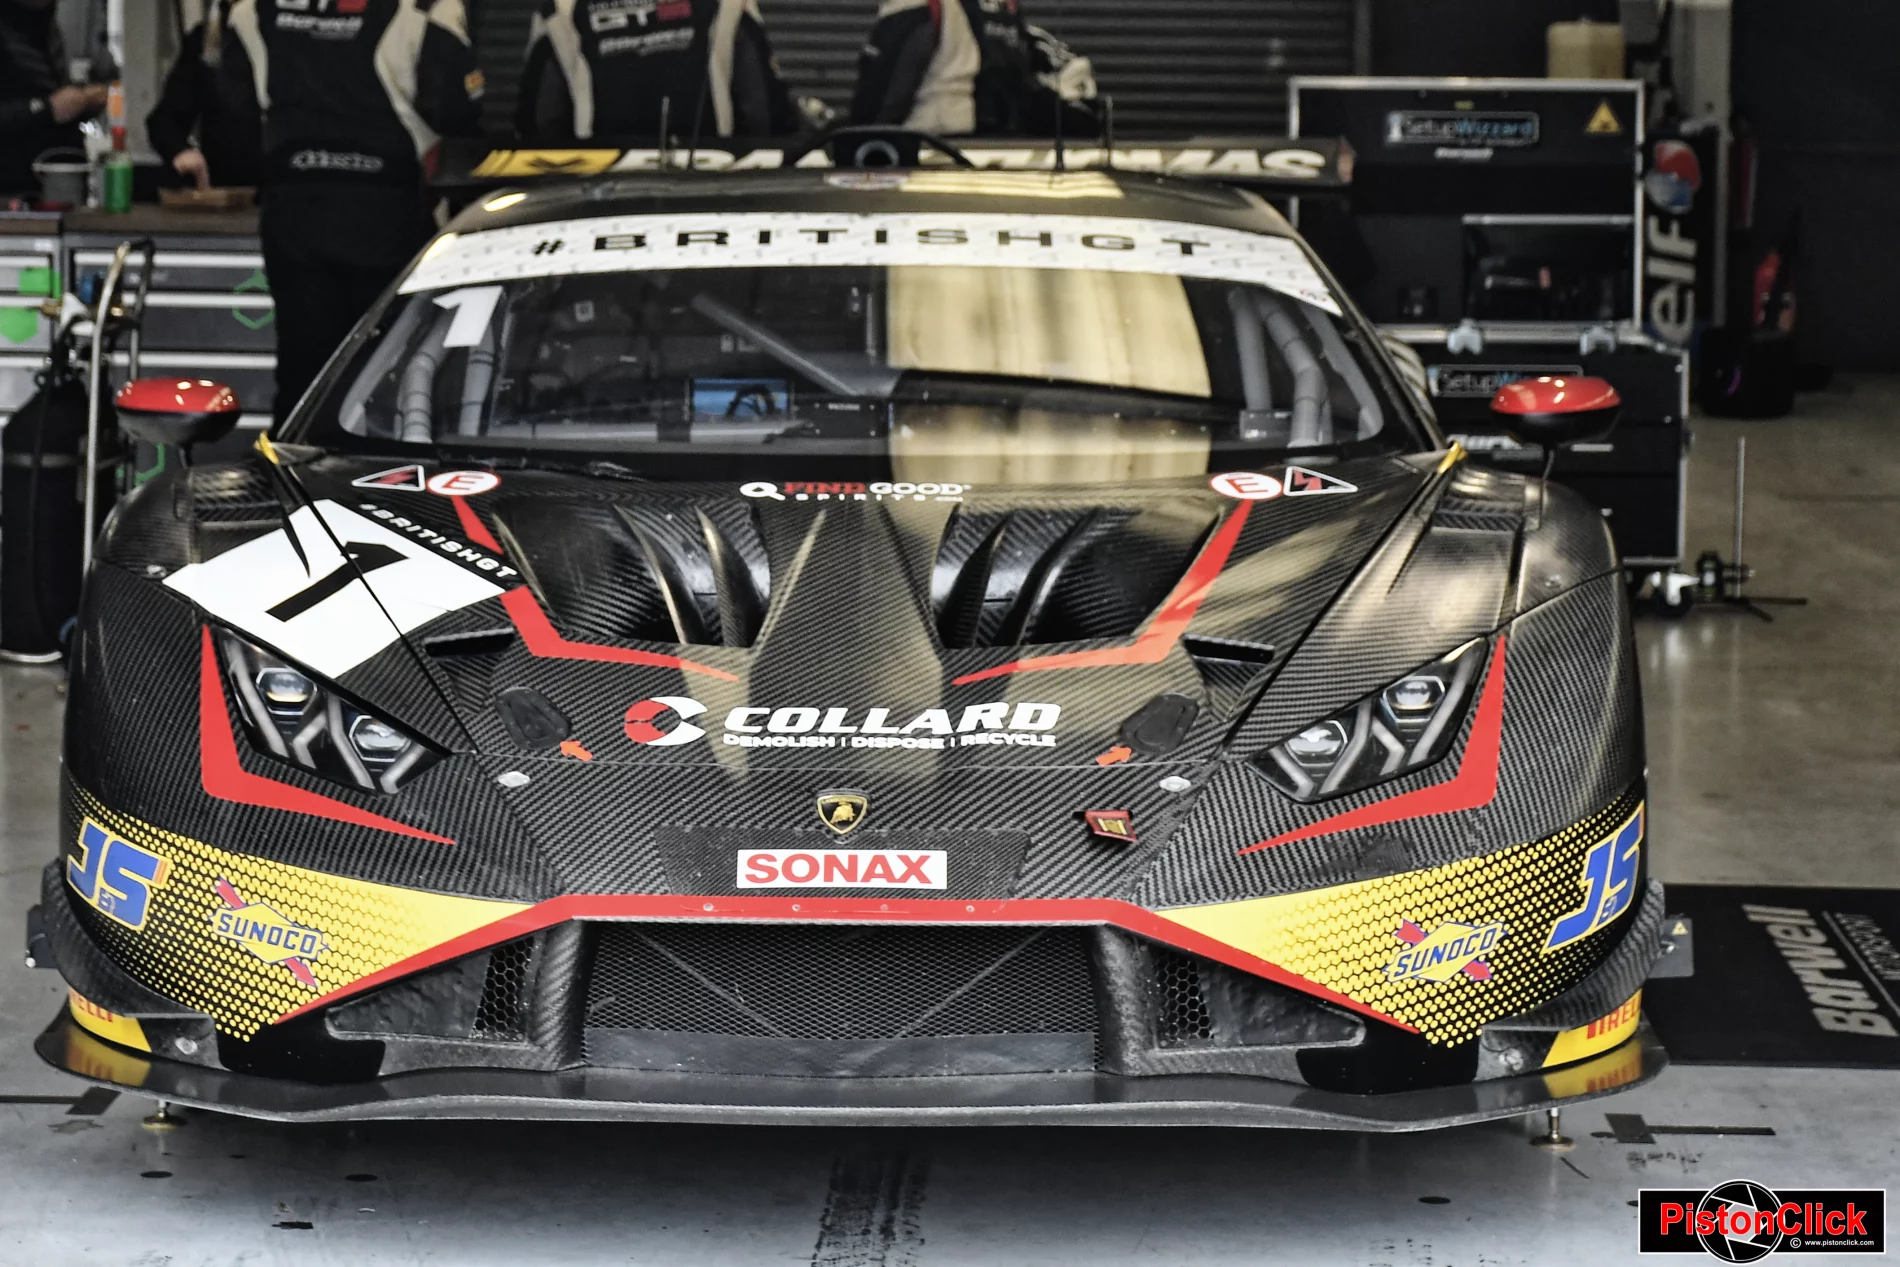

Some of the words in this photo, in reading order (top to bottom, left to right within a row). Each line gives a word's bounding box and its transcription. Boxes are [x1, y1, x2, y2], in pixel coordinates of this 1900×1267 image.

[432, 284, 503, 348] 1
[265, 541, 409, 622] 1
[722, 733, 835, 748] DEMOLISH
[851, 736, 945, 750] DISPOSE
[960, 733, 1057, 748] RECYCLE
[723, 701, 1062, 735] COLLARD
[68, 818, 170, 929] JS
[745, 853, 933, 884] SONAX
[1543, 803, 1643, 953] JS
[217, 913, 318, 954] SUNOCO
[1394, 927, 1497, 977] SUNOCO
[1741, 904, 1899, 1037] Barwell
